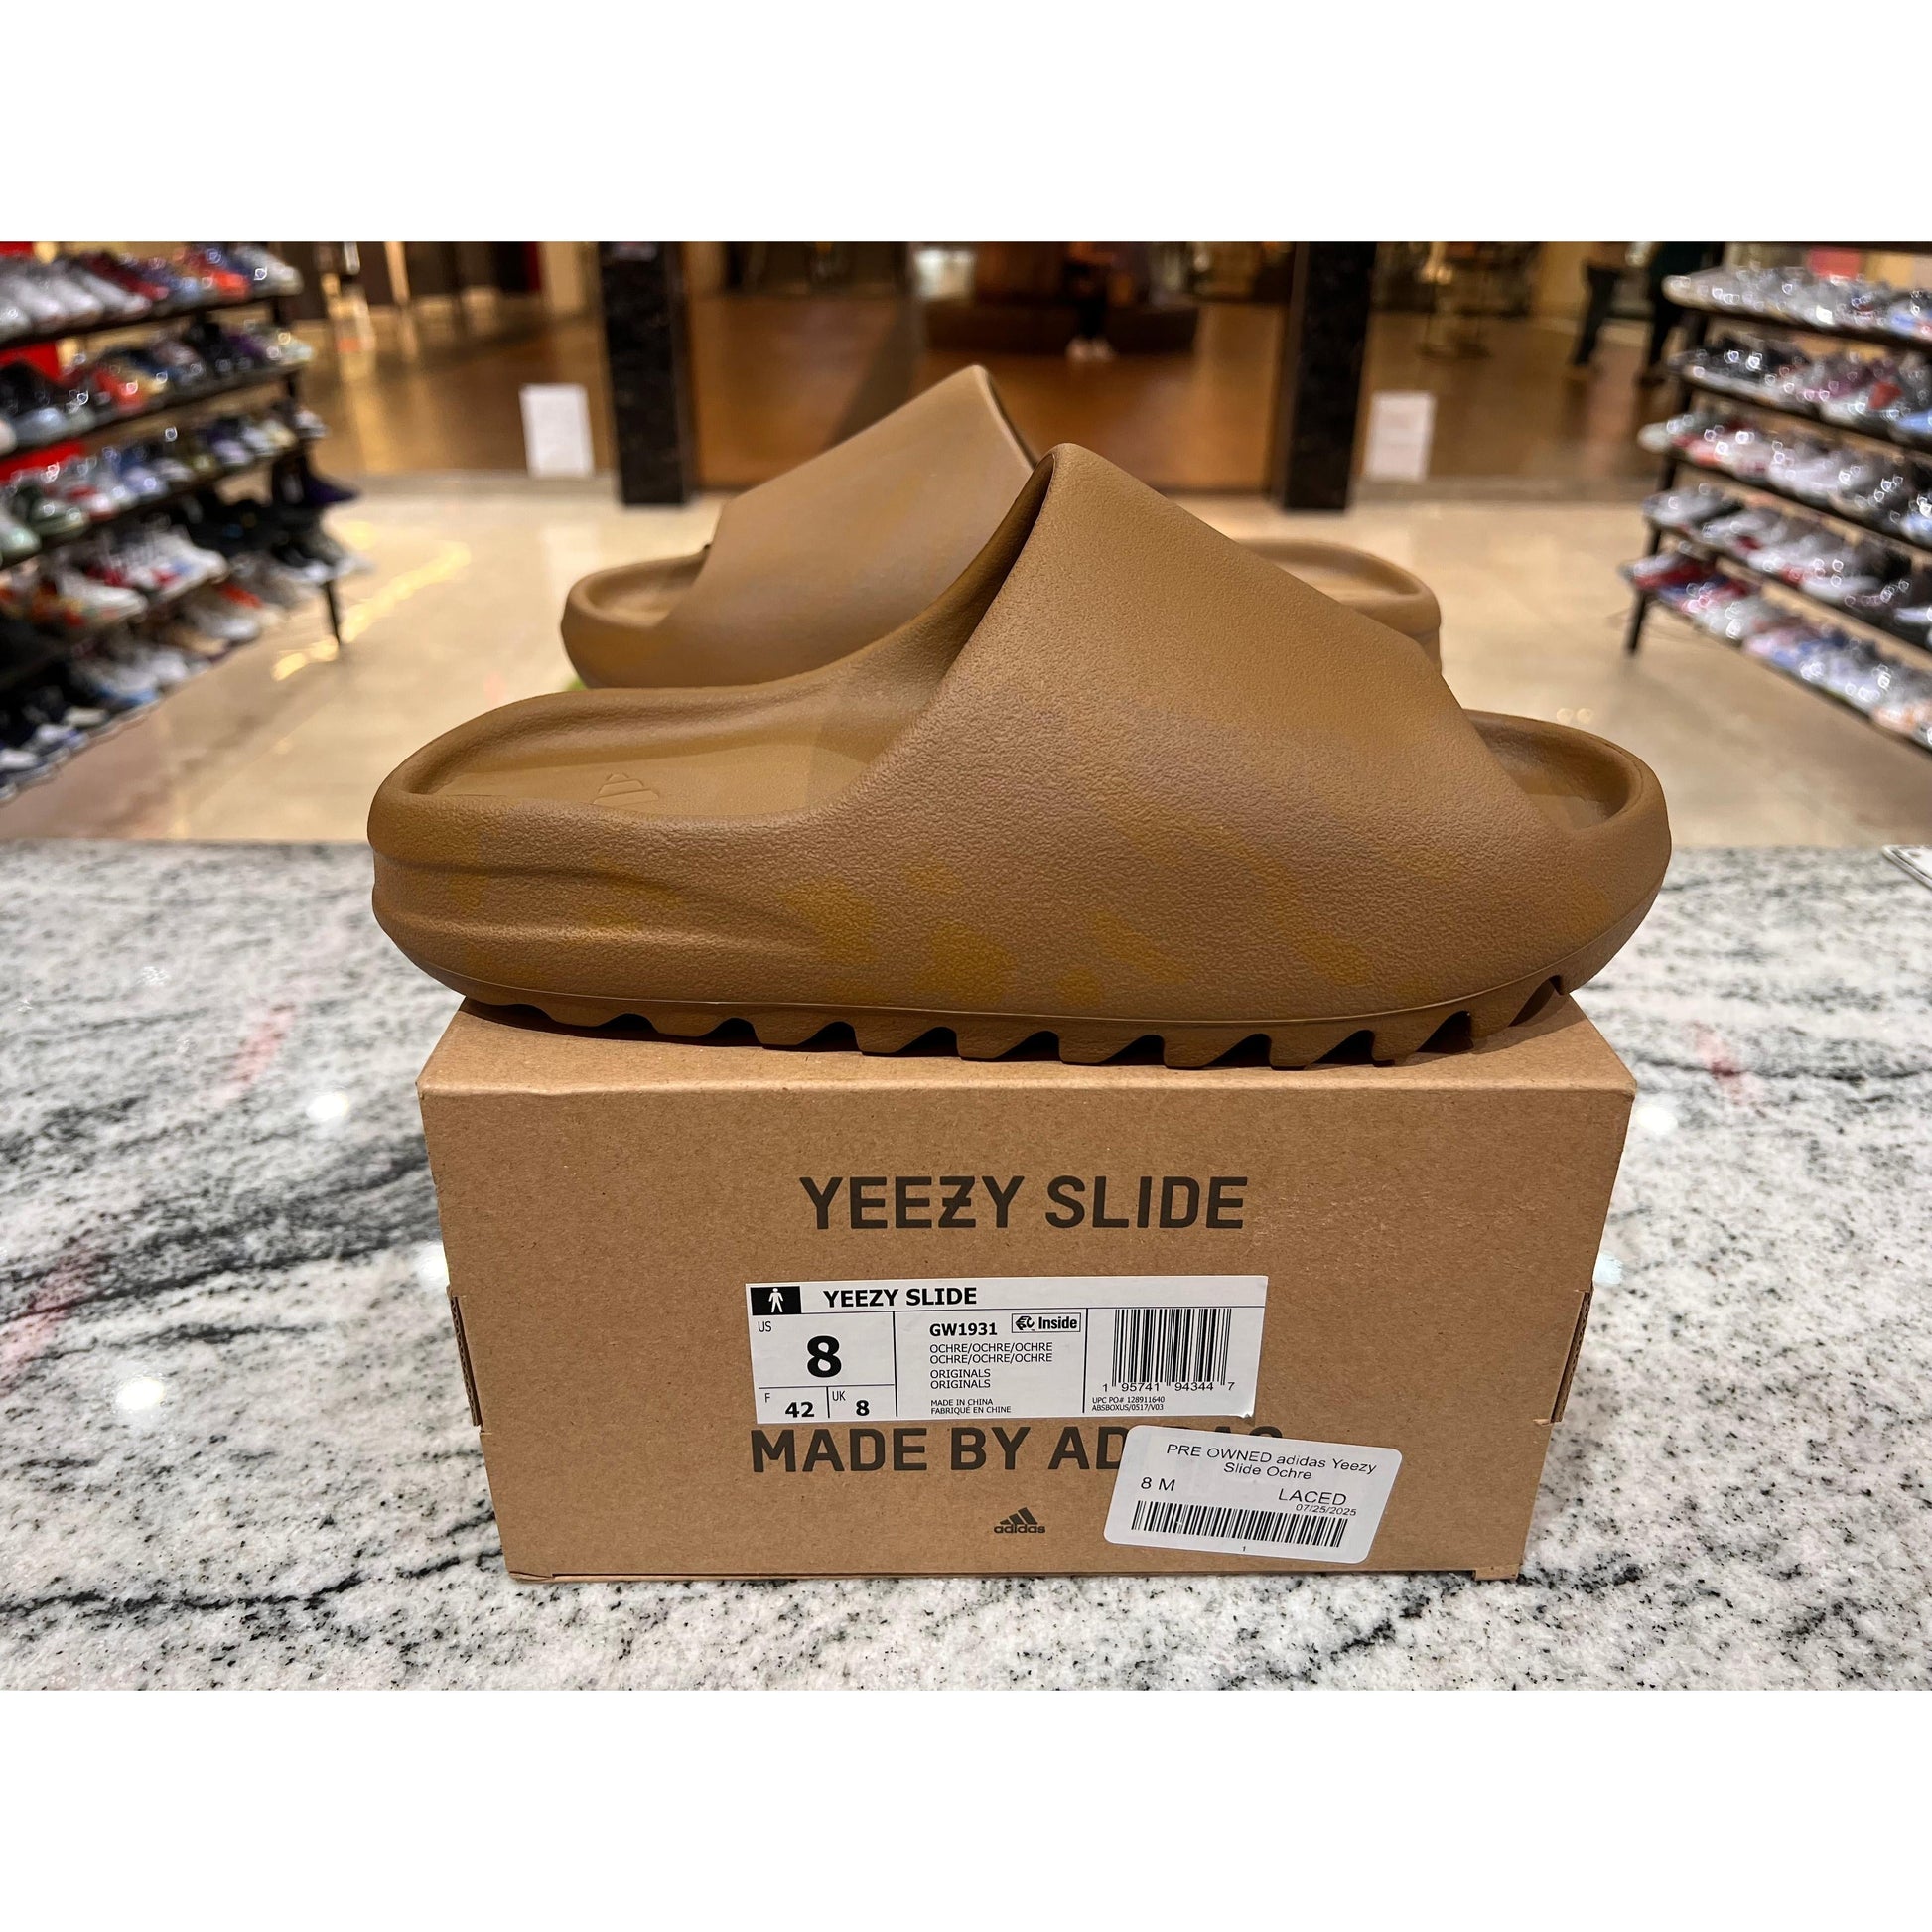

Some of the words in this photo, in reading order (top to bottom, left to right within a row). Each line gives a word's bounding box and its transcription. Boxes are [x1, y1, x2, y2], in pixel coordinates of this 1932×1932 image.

[1045, 1175, 1249, 1231] SLIDE
[822, 1288, 899, 1309] YEEZY
[905, 1286, 978, 1307] SLIDE
[757, 1320, 773, 1333] US
[929, 1322, 999, 1337] GW1931
[1038, 1316, 1078, 1329] Inside
[929, 1341, 1054, 1354] OCHRE/OCHRE/OCHRE
[806, 1335, 843, 1378] 8
[929, 1352, 1054, 1365] OCHRE/OCHRE/OCHRE
[929, 1368, 992, 1379] ORIGINALS
[929, 1378, 992, 1390] ORIGINALS
[1102, 1383, 1109, 1393] 1
[1120, 1382, 1161, 1392] 95741
[1173, 1381, 1214, 1391] 94344
[1227, 1381, 1236, 1391] 7
[763, 1392, 771, 1404] F
[831, 1390, 847, 1402] UK
[784, 1401, 816, 1419] 42
[855, 1399, 871, 1417] 8
[751, 1427, 928, 1473] MADE
[949, 1426, 1032, 1471] BY
[1167, 1444, 1201, 1457] PRE
[1206, 1448, 1272, 1464] OWNED
[1276, 1453, 1327, 1469] adidas
[1332, 1457, 1378, 1477] Yeezy
[1223, 1462, 1262, 1476] Slide
[1266, 1465, 1312, 1481] Ochre
[1140, 1477, 1152, 1490] 8
[1158, 1478, 1175, 1491] M
[1278, 1488, 1347, 1506] LACED
[1295, 1503, 1357, 1517] 07/25/2025
[993, 1523, 1046, 1534] adidas
